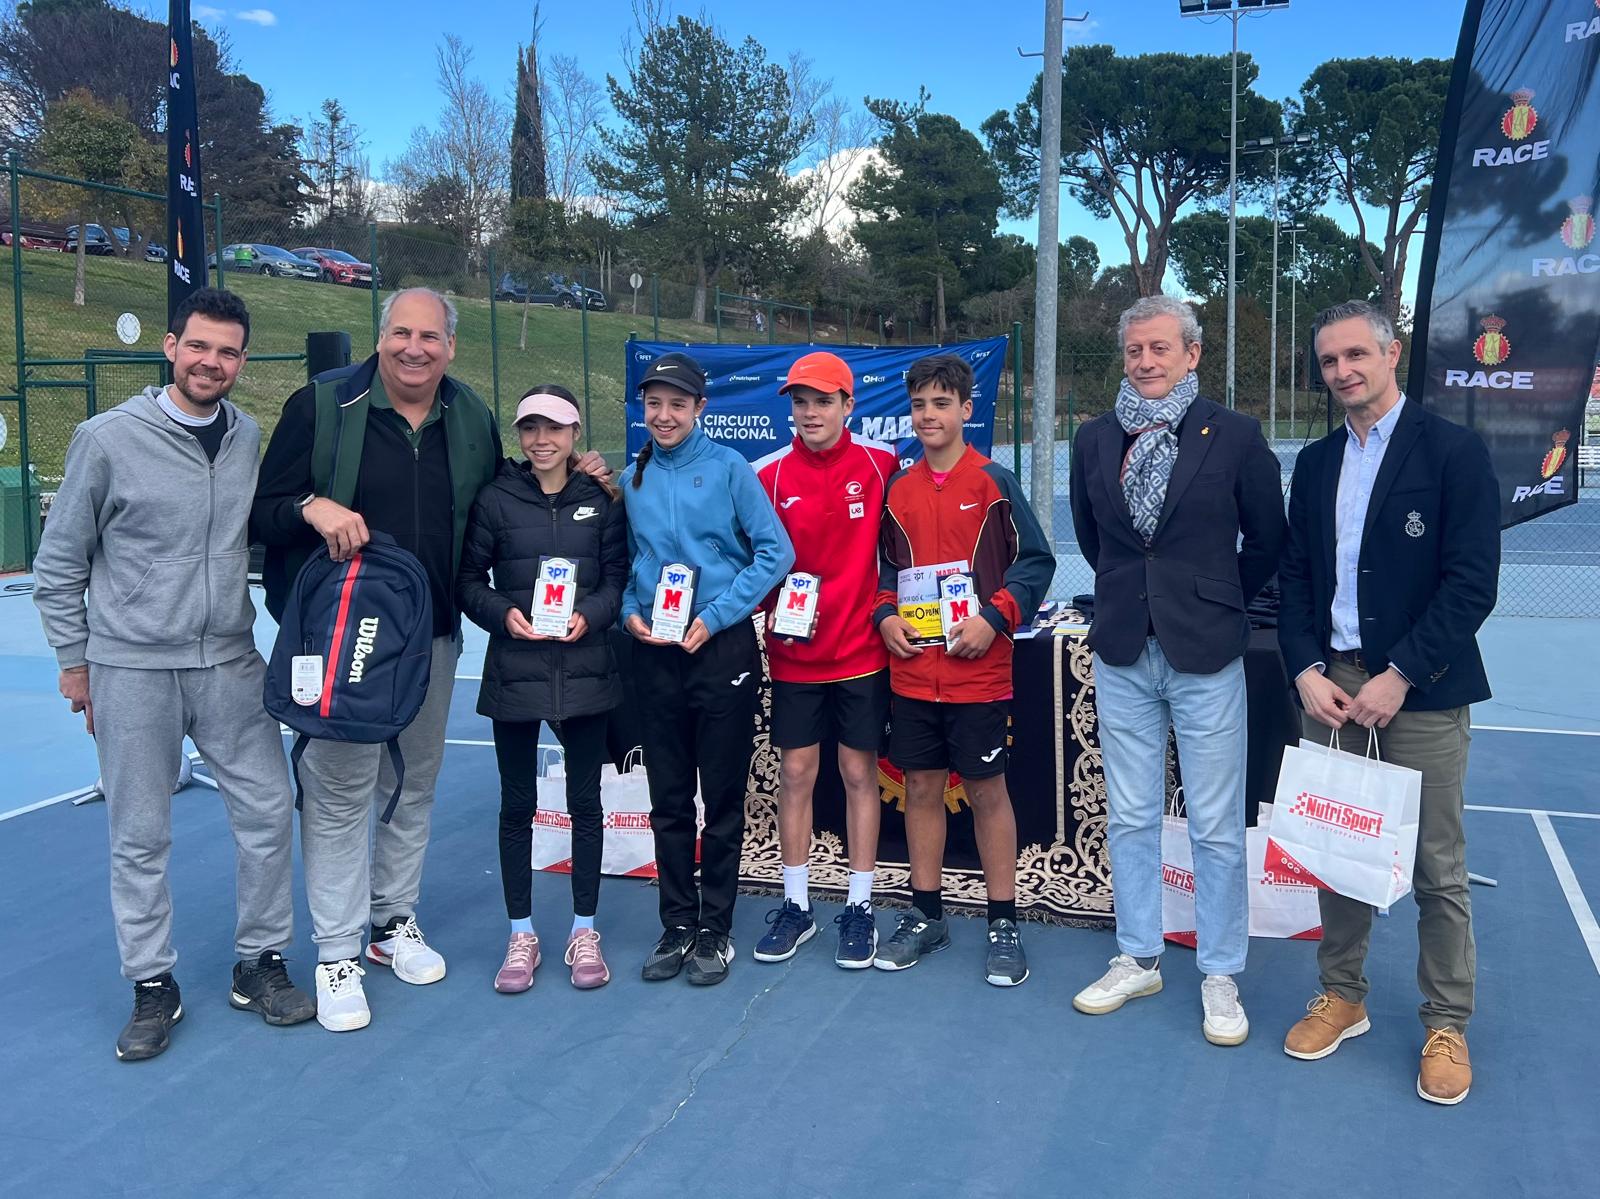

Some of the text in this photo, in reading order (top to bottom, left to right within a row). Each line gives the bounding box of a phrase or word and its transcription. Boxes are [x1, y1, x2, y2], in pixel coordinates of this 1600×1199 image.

[1472, 139, 1550, 167] RACE
[1532, 254, 1600, 277] RAC
[1445, 369, 1534, 390] RACE
[703, 414, 771, 427] CIRCUITO
[861, 415, 917, 441] MAR
[703, 427, 777, 440] NACIONAL
[544, 583, 565, 606] M
[662, 588, 683, 611] M
[787, 591, 808, 610] M
[950, 600, 970, 622] M
[348, 617, 379, 683] Wilson
[1305, 797, 1384, 835] NutriSport
